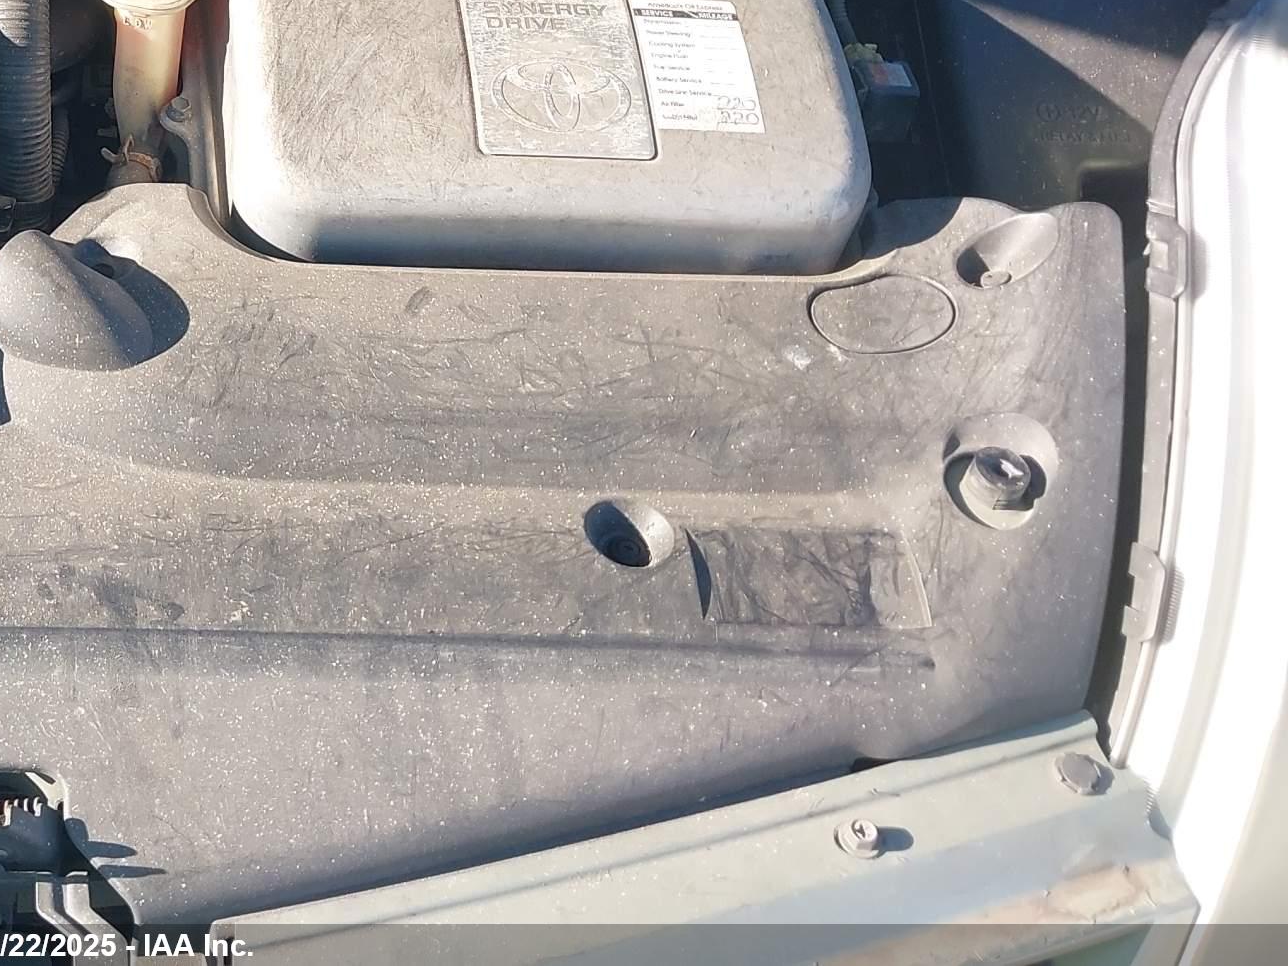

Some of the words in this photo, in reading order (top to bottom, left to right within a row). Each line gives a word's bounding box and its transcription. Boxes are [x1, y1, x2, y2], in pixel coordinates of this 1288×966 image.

[484, 2, 607, 16] SYNERGY
[641, 9, 673, 17] SERVICE
[698, 12, 733, 20] MILEAGE
[486, 17, 568, 31] DRIVE
